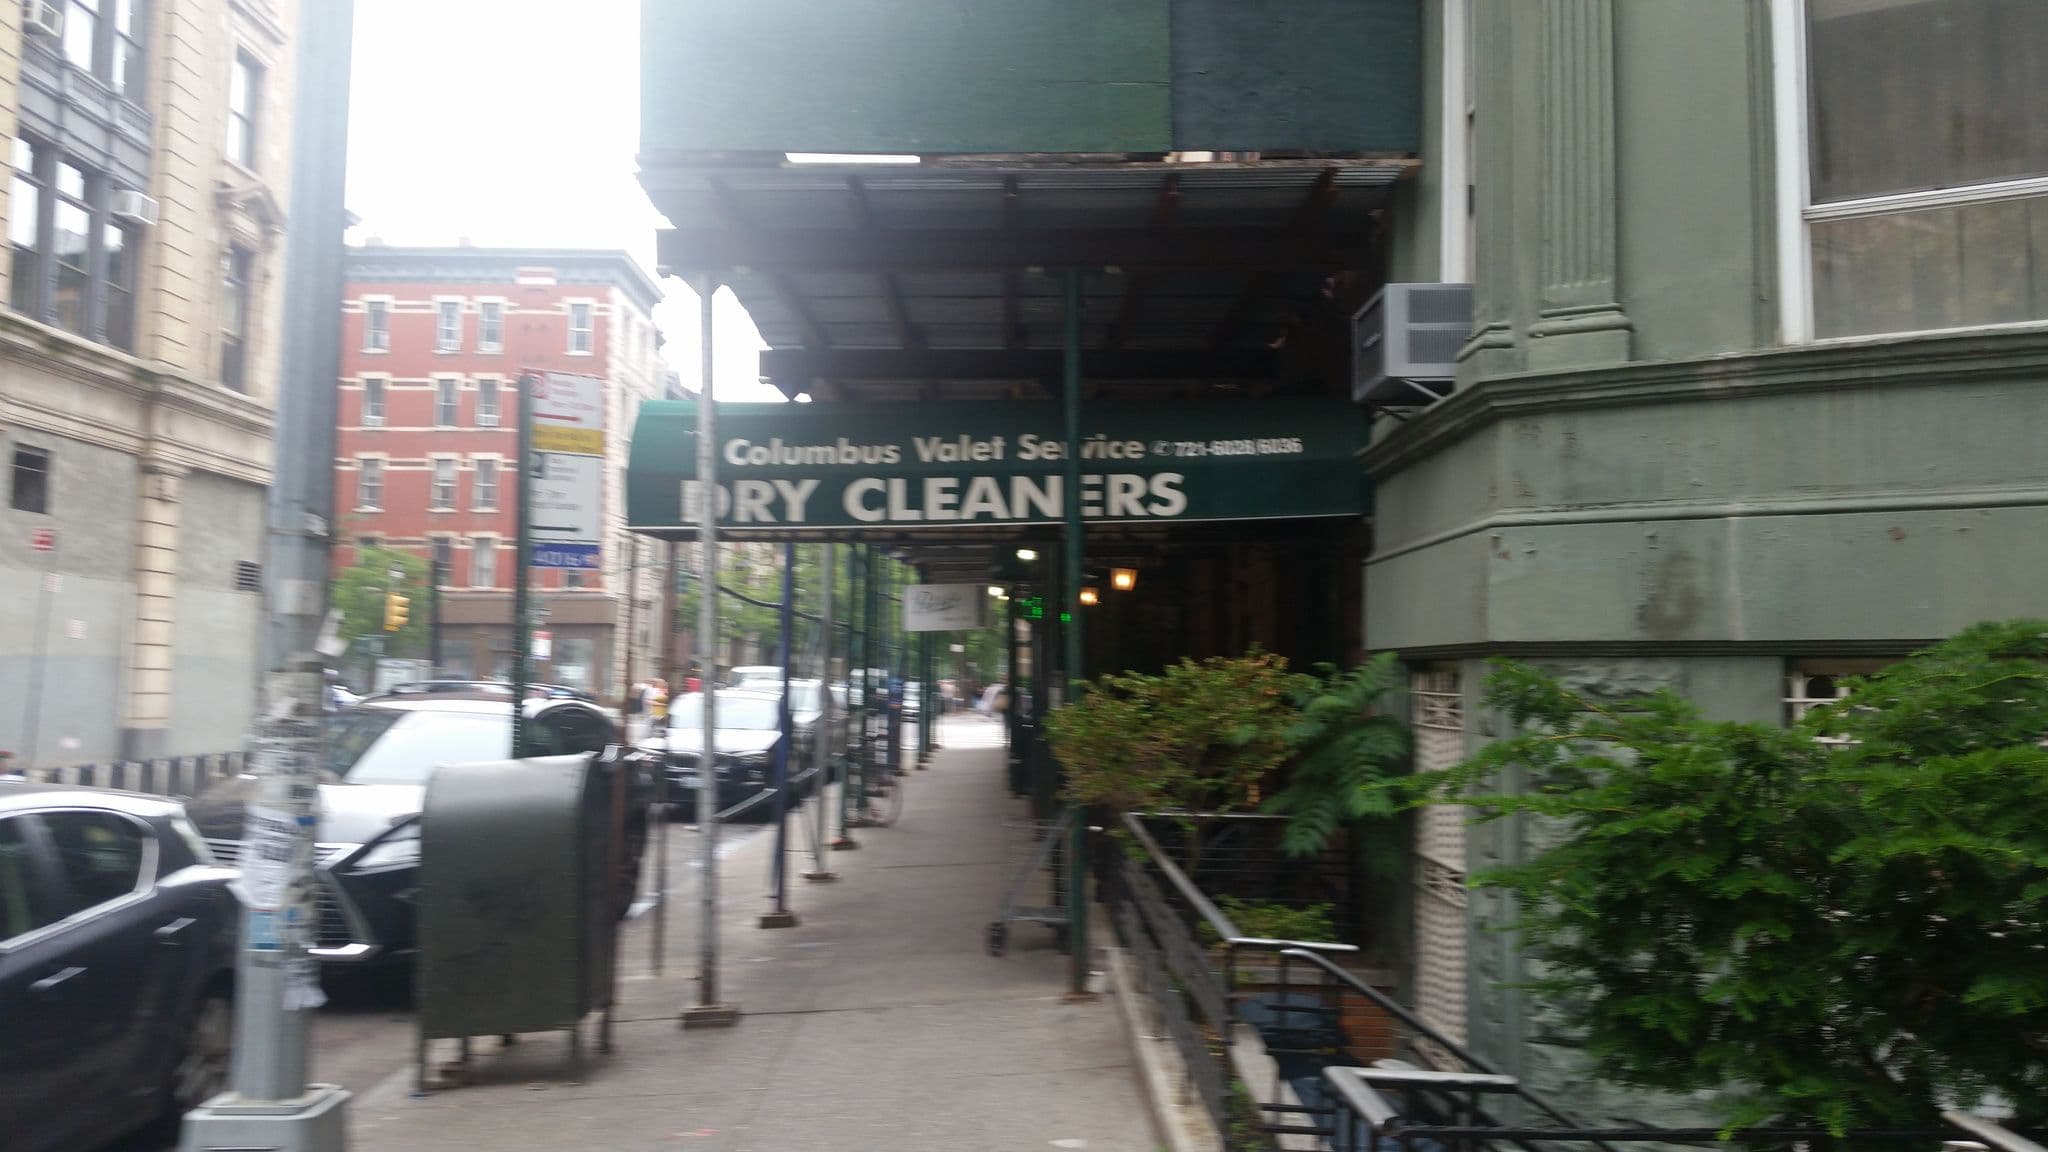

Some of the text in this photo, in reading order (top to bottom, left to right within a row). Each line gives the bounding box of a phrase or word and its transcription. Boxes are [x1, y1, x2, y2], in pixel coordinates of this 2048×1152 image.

[724, 438, 900, 465] Columbus
[912, 434, 1006, 462] Valet
[680, 473, 1187, 522] DRY CLEANERS
